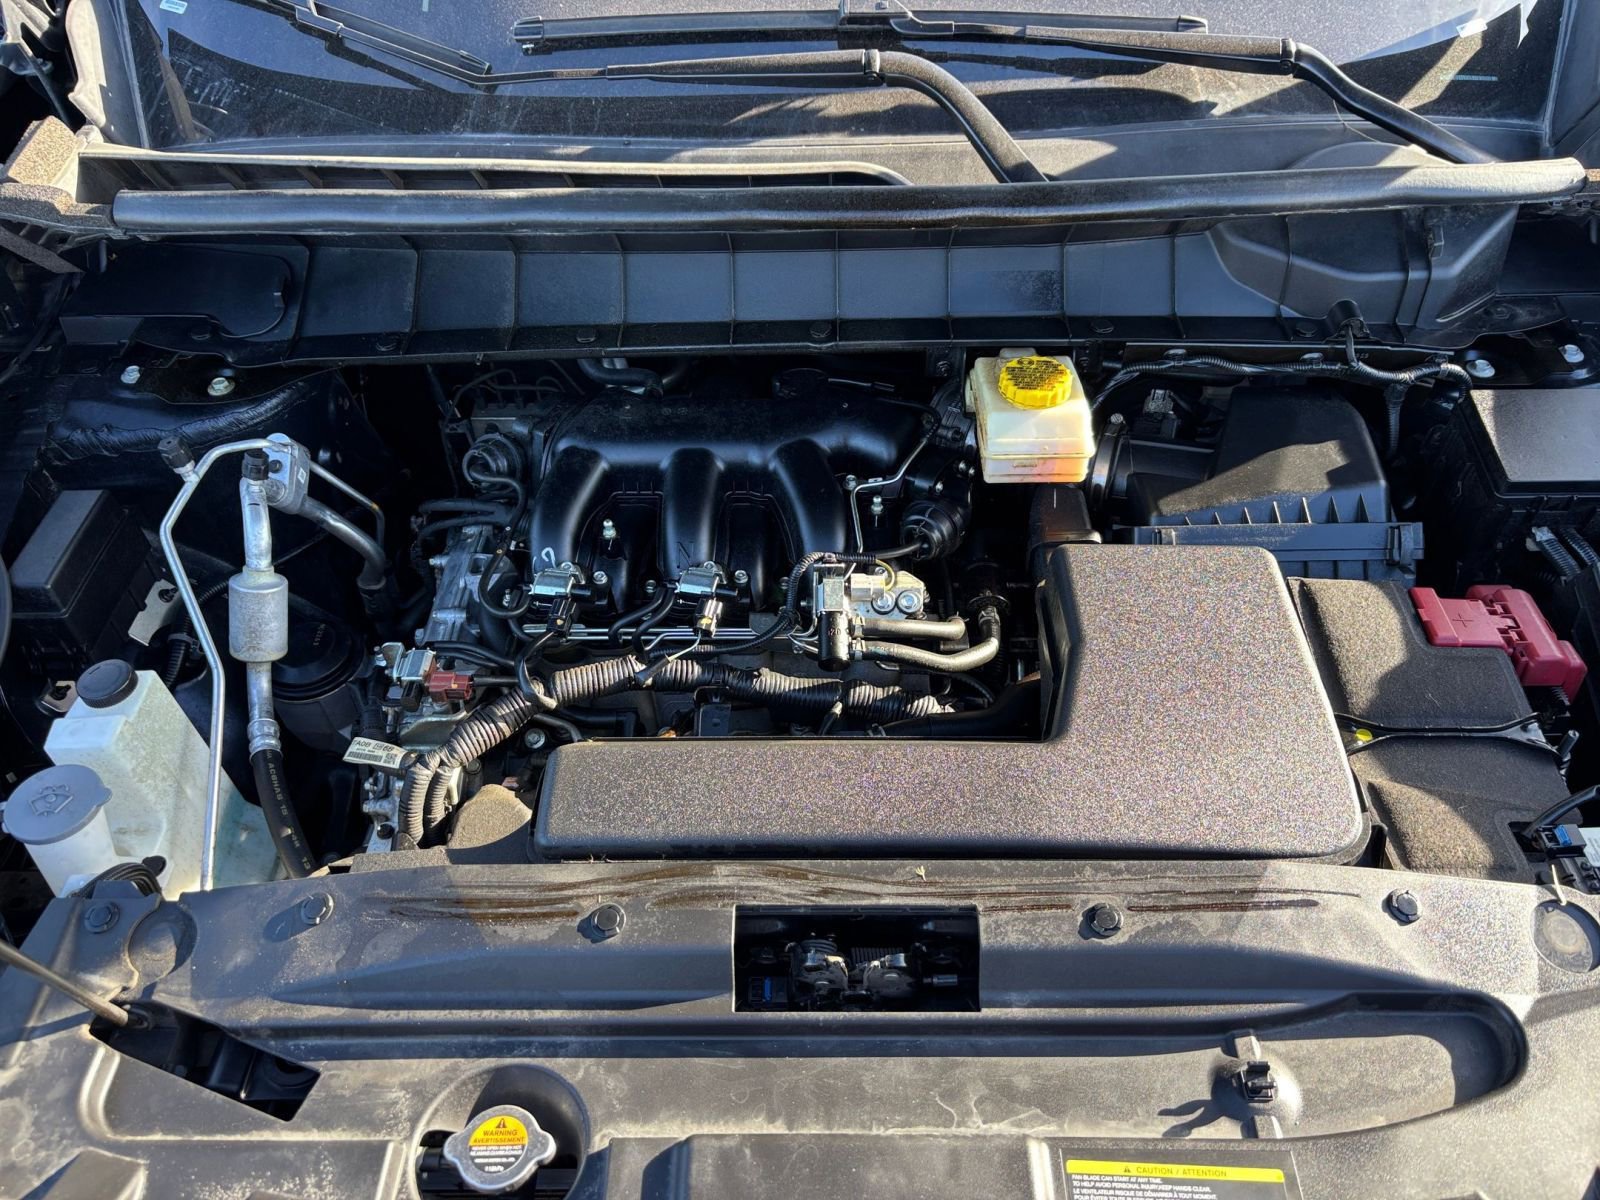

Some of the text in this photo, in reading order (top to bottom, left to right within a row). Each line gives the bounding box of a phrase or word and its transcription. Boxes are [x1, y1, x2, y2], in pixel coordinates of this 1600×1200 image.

[483, 1129, 518, 1137] WARNING
[473, 1136, 526, 1144] AVERTISSEMENT
[1136, 1166, 1173, 1175] CAUTION
[1182, 1168, 1227, 1177] ATTENTION
